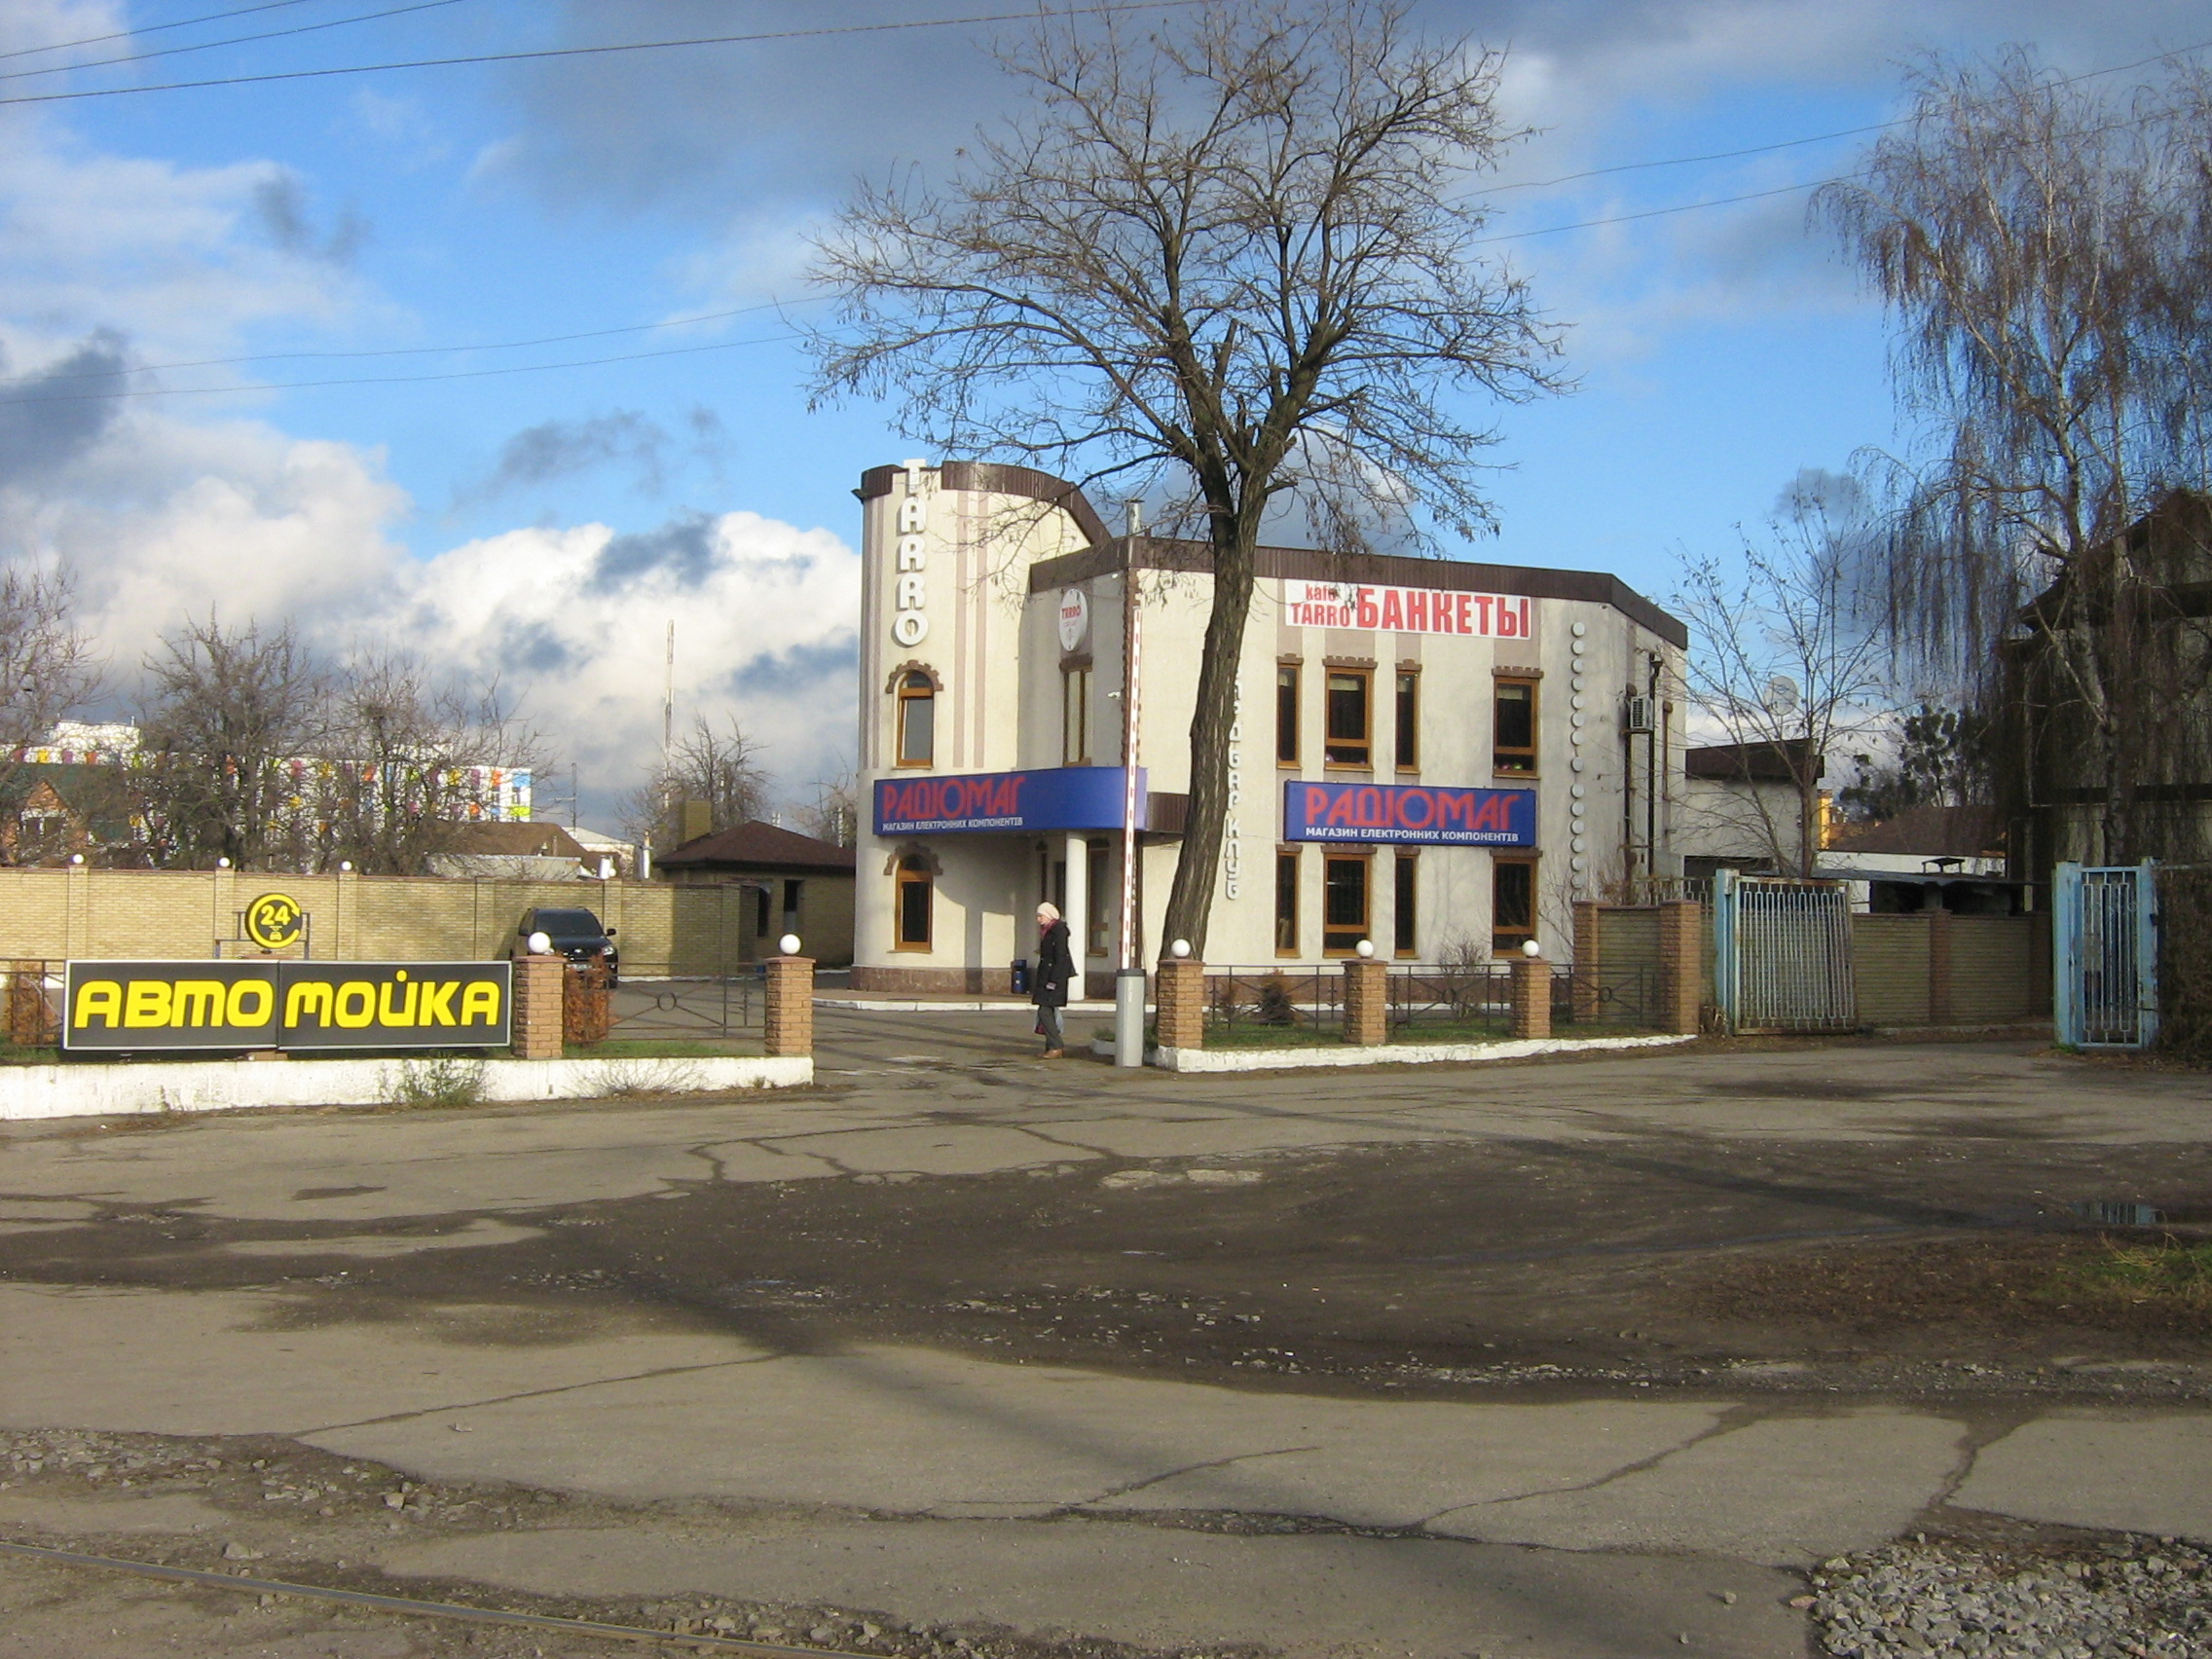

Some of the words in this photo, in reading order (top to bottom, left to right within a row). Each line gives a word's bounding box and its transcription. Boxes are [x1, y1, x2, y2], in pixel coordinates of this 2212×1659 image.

[895, 459, 928, 645] TARRO
[1291, 602, 1350, 628] TARRO
[1356, 587, 1530, 639] БАНКЕТЫ
[883, 821, 914, 830] МАГАЗИН
[1306, 827, 1358, 838] МАГАЗИН
[1360, 829, 1439, 840] ЕЛЕКТРОННИХ
[1441, 830, 1519, 842] КОМПОНЕНТІВ
[259, 904, 291, 926] 24
